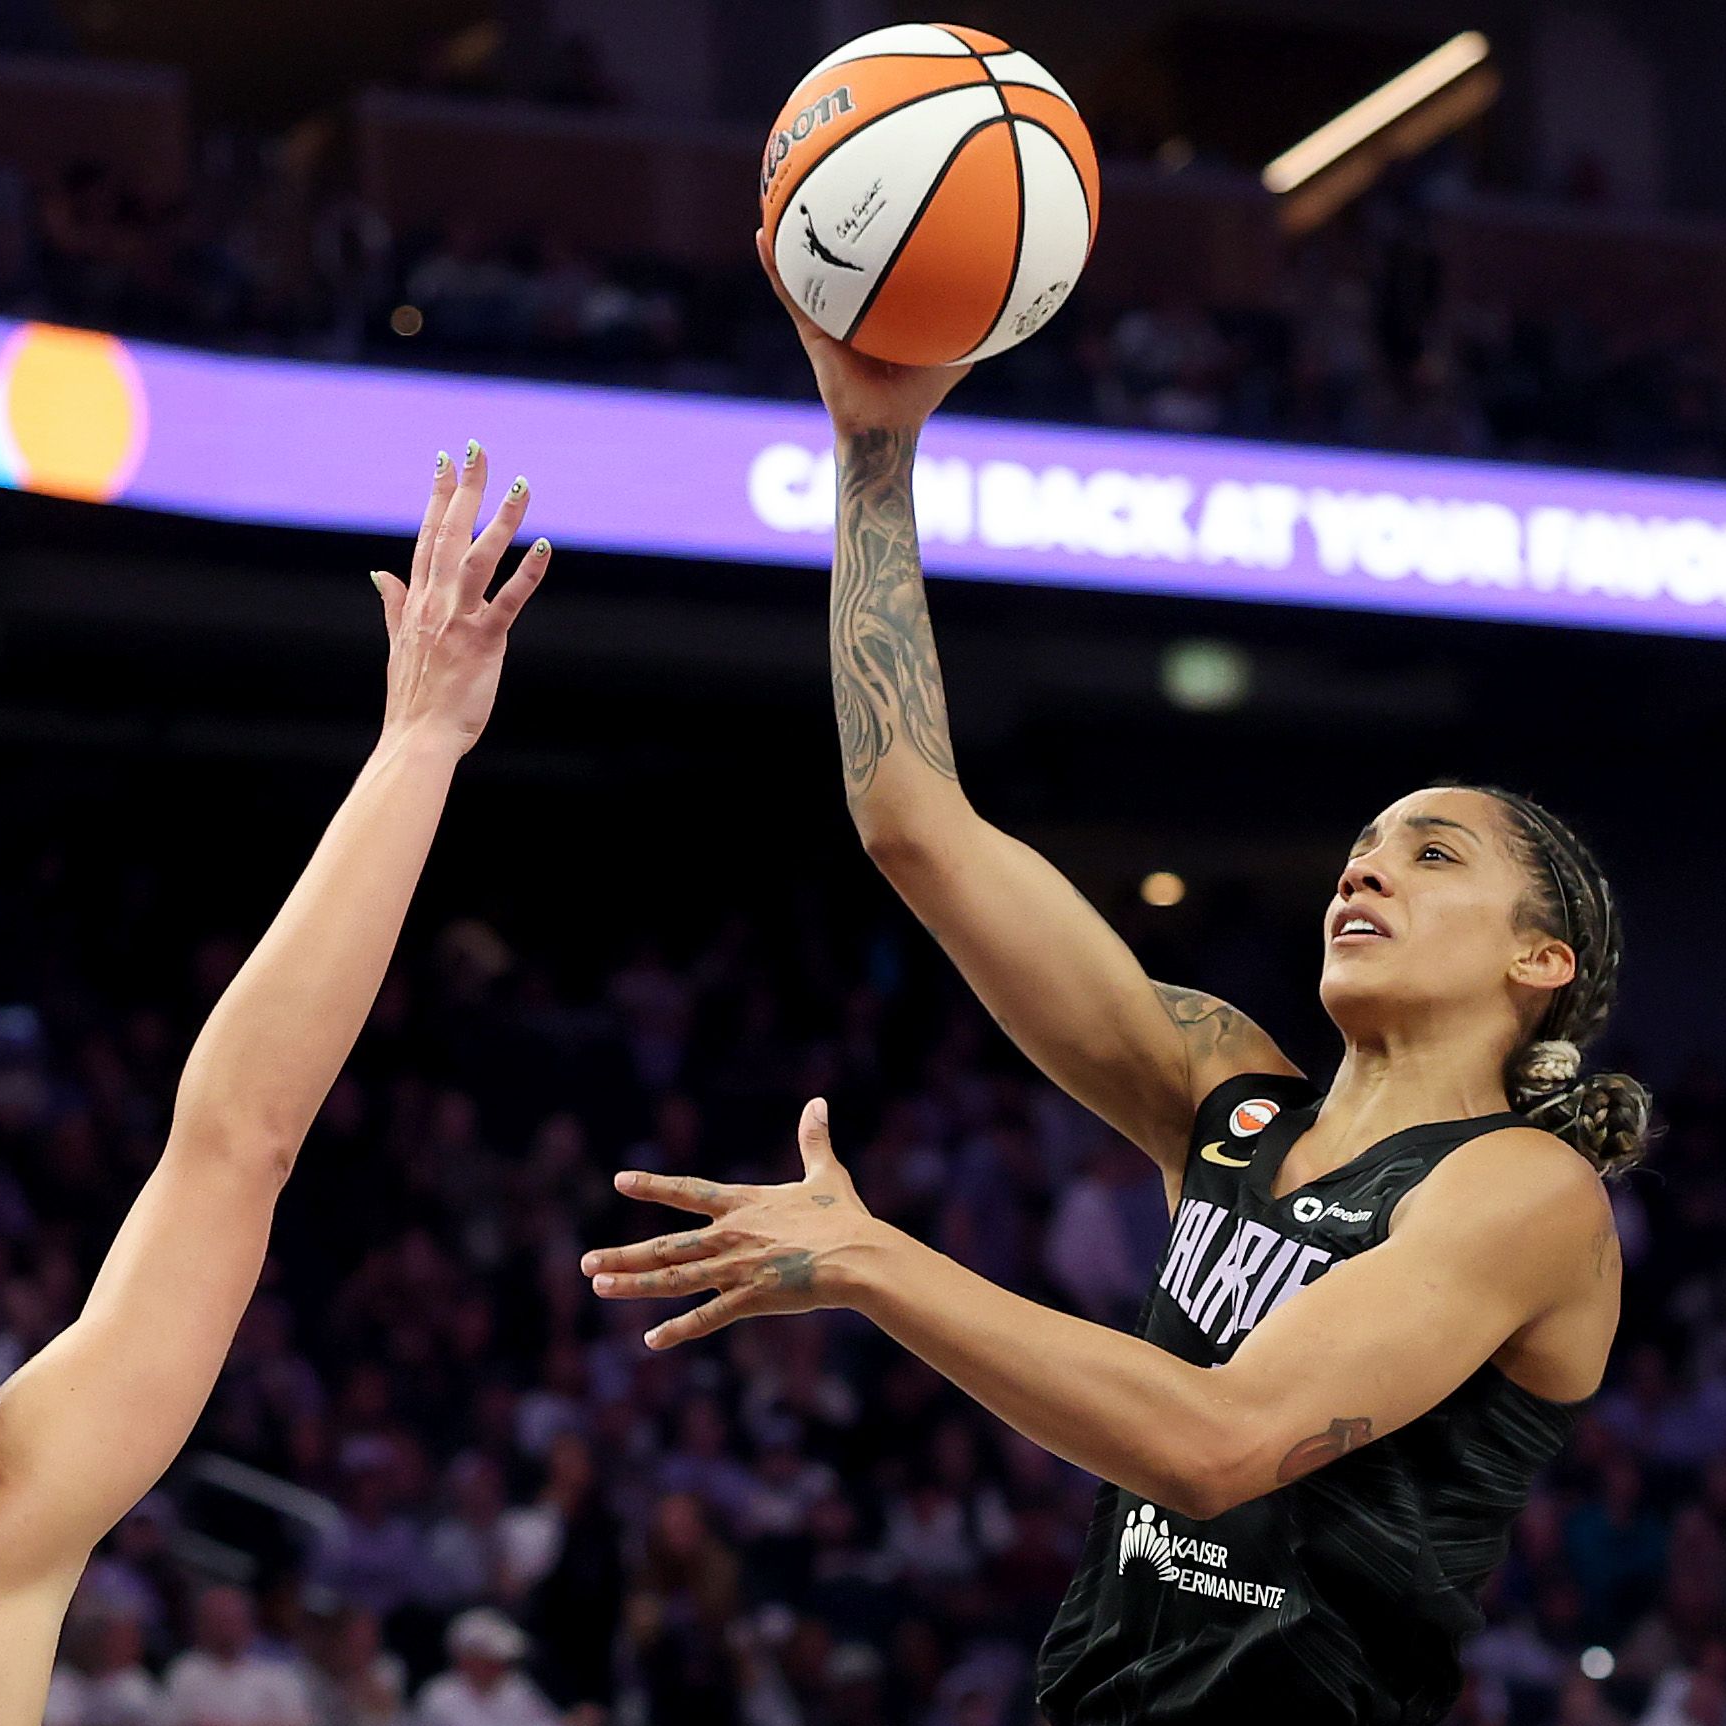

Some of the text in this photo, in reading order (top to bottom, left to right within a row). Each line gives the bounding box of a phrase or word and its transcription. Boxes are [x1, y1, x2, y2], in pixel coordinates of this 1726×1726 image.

[977, 462, 1193, 562] BACK
[1195, 483, 1303, 567] AT
[1306, 493, 1523, 585] YOUR
[1319, 1201, 1373, 1223] freedom
[1171, 1535, 1228, 1569] KAISER
[1169, 1565, 1286, 1609] PERMANENTE
